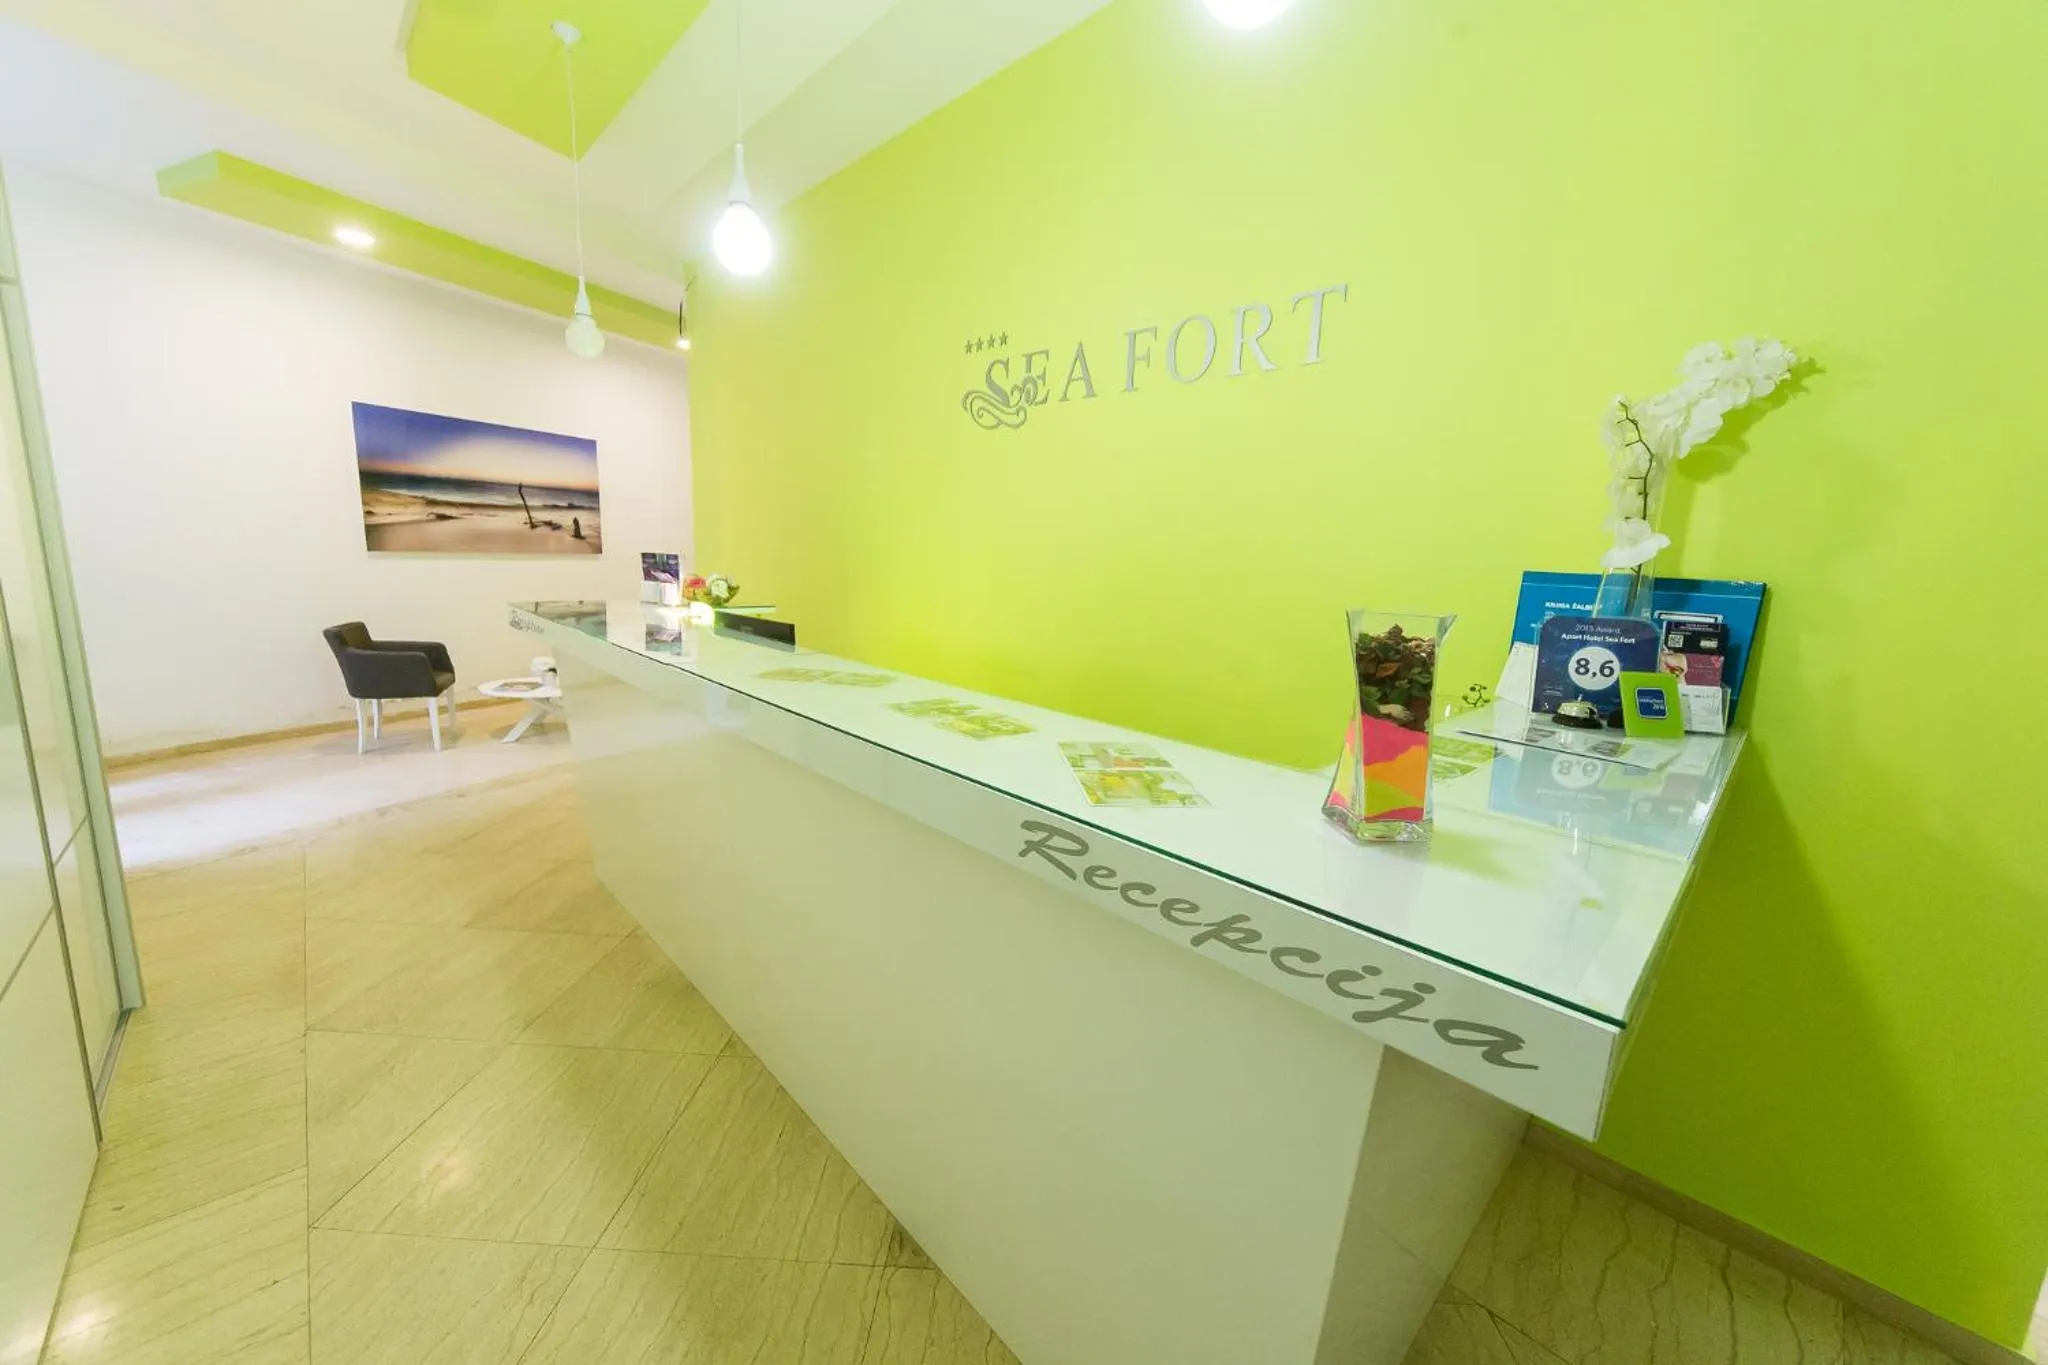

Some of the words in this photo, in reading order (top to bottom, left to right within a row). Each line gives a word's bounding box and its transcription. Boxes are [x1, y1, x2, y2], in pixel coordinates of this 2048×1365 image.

[962, 341, 1098, 430] SEA
[1119, 284, 1349, 394] FORT
[1574, 657, 1615, 678] 8,6
[1018, 819, 1539, 1070] Recepcija
